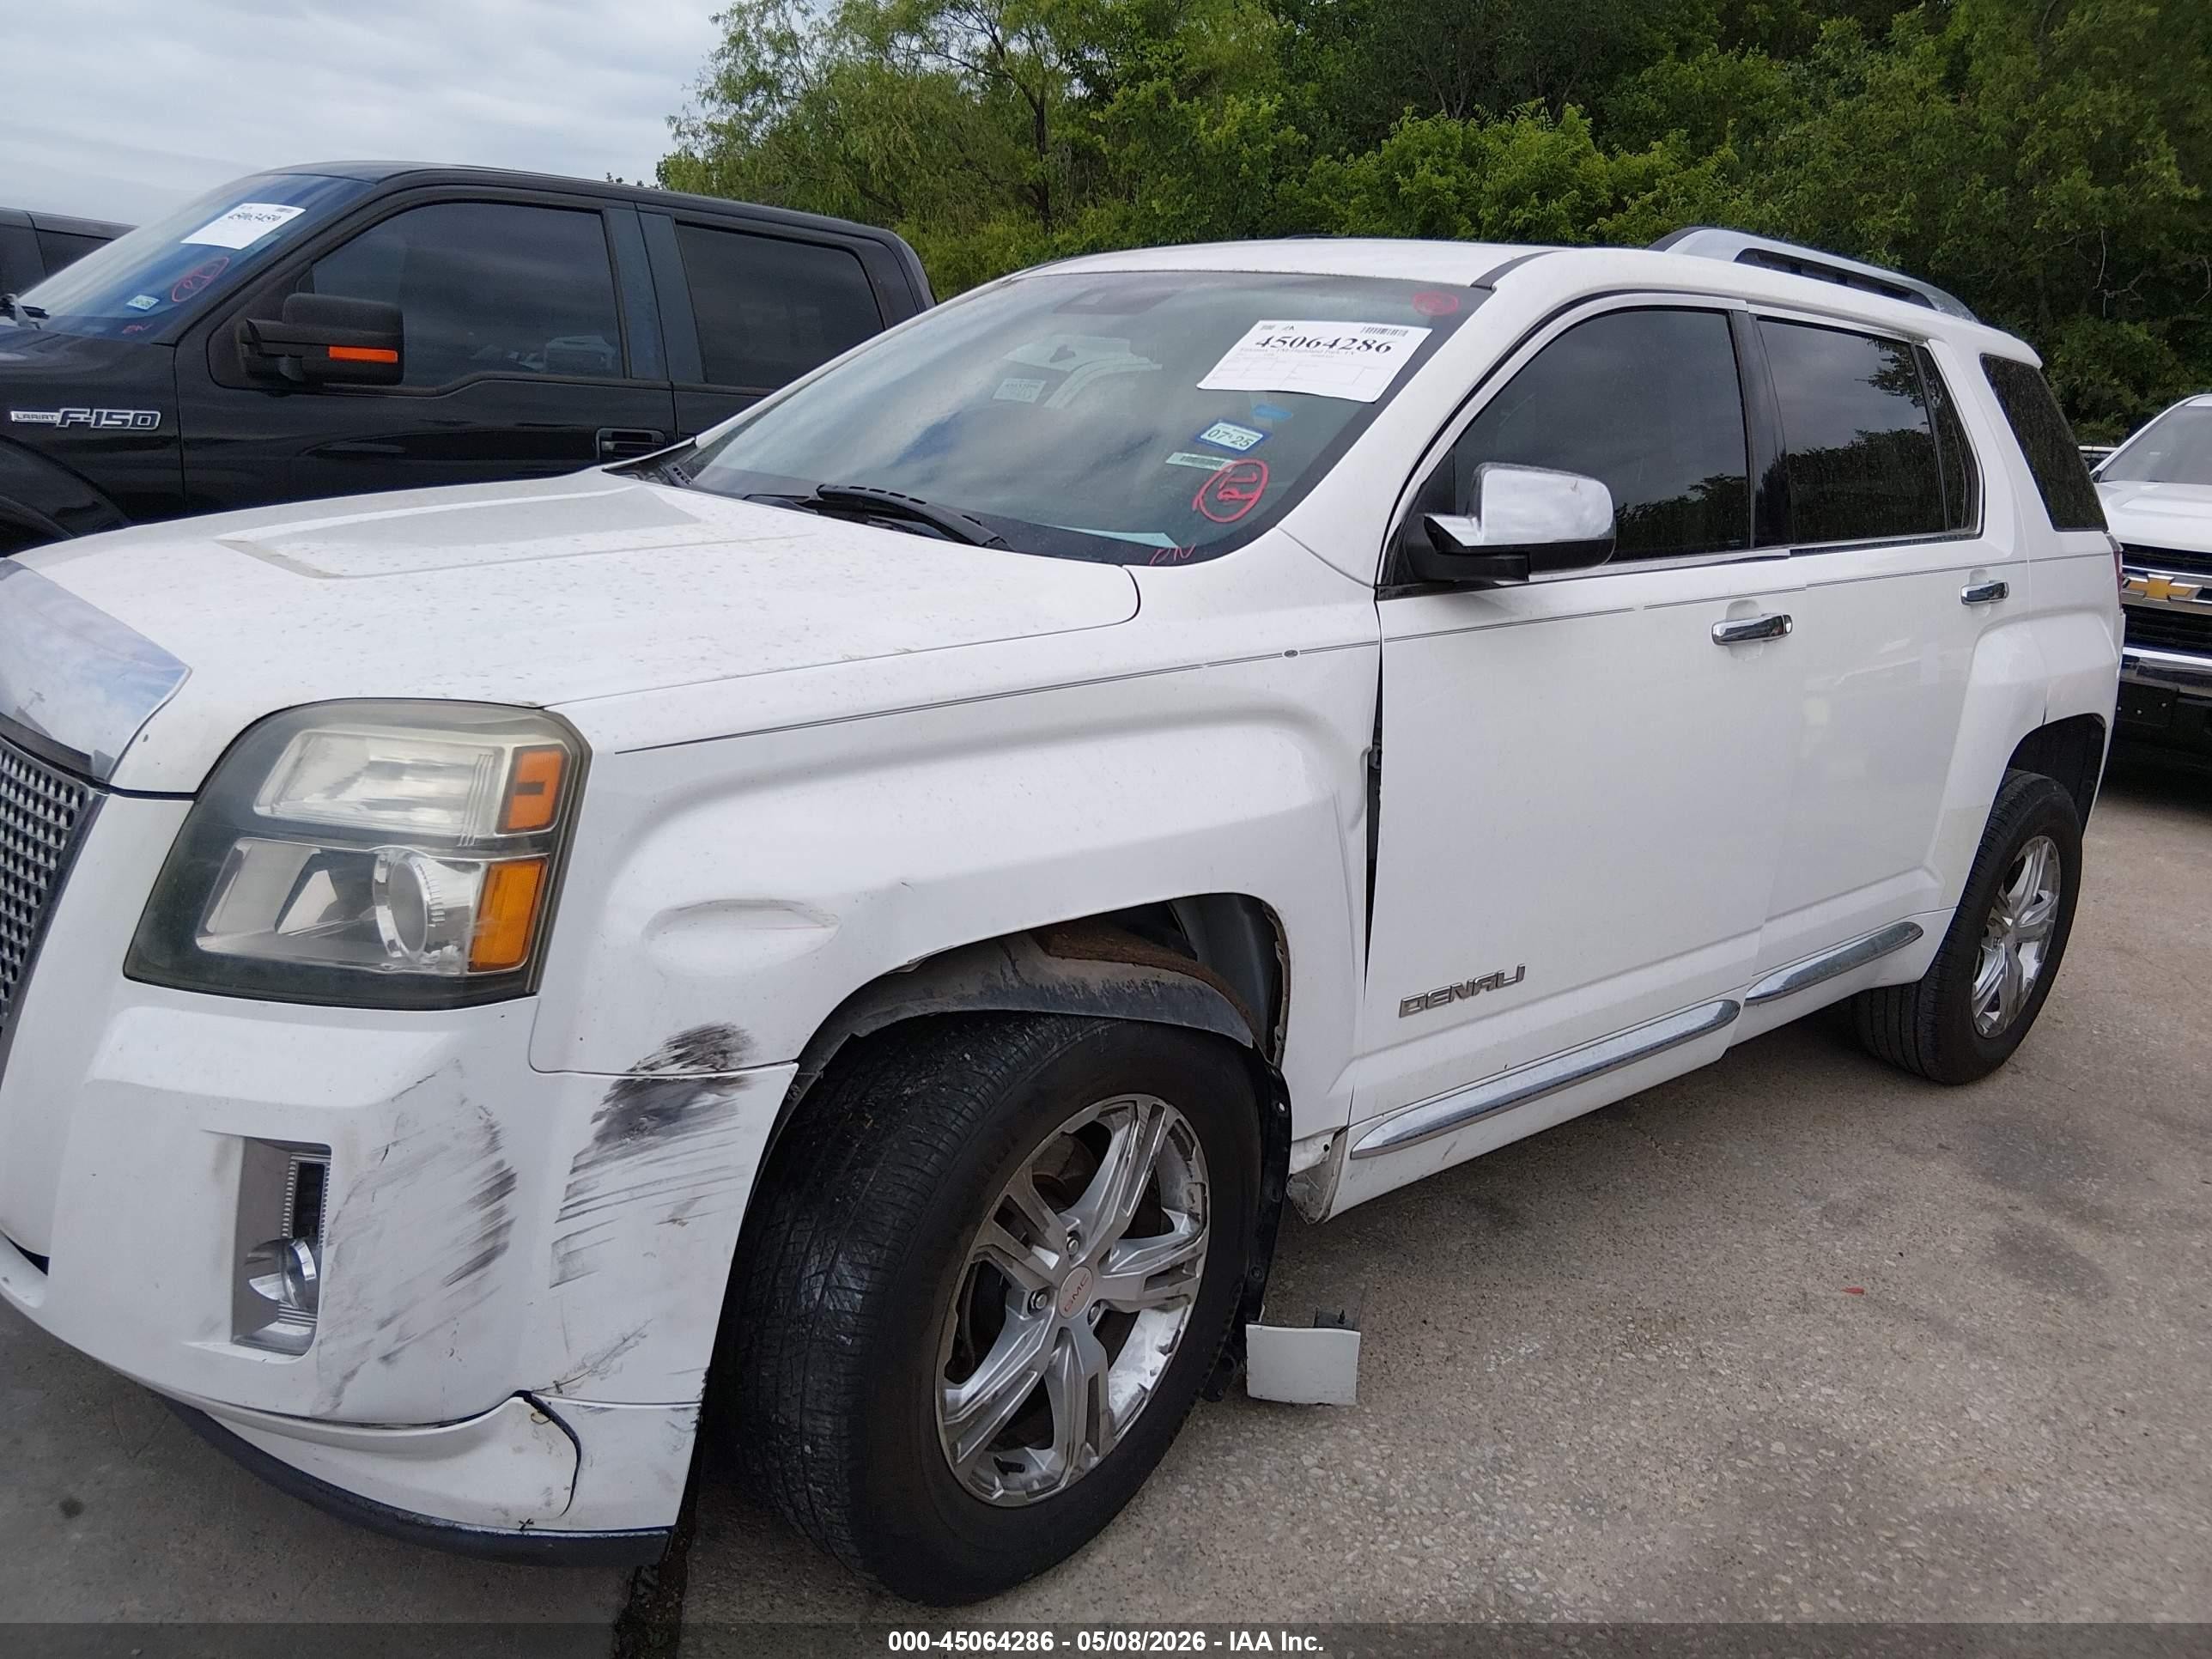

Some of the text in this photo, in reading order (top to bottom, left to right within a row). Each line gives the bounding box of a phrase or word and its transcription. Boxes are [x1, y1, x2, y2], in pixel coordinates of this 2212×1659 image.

[1255, 335, 1396, 355] 45064286
[57, 408, 161, 430] F-150
[1207, 428, 1229, 440] 07
[1230, 434, 1254, 447] 25
[1398, 963, 1526, 1018] DENALI
[1064, 1273, 1089, 1313] GMC
